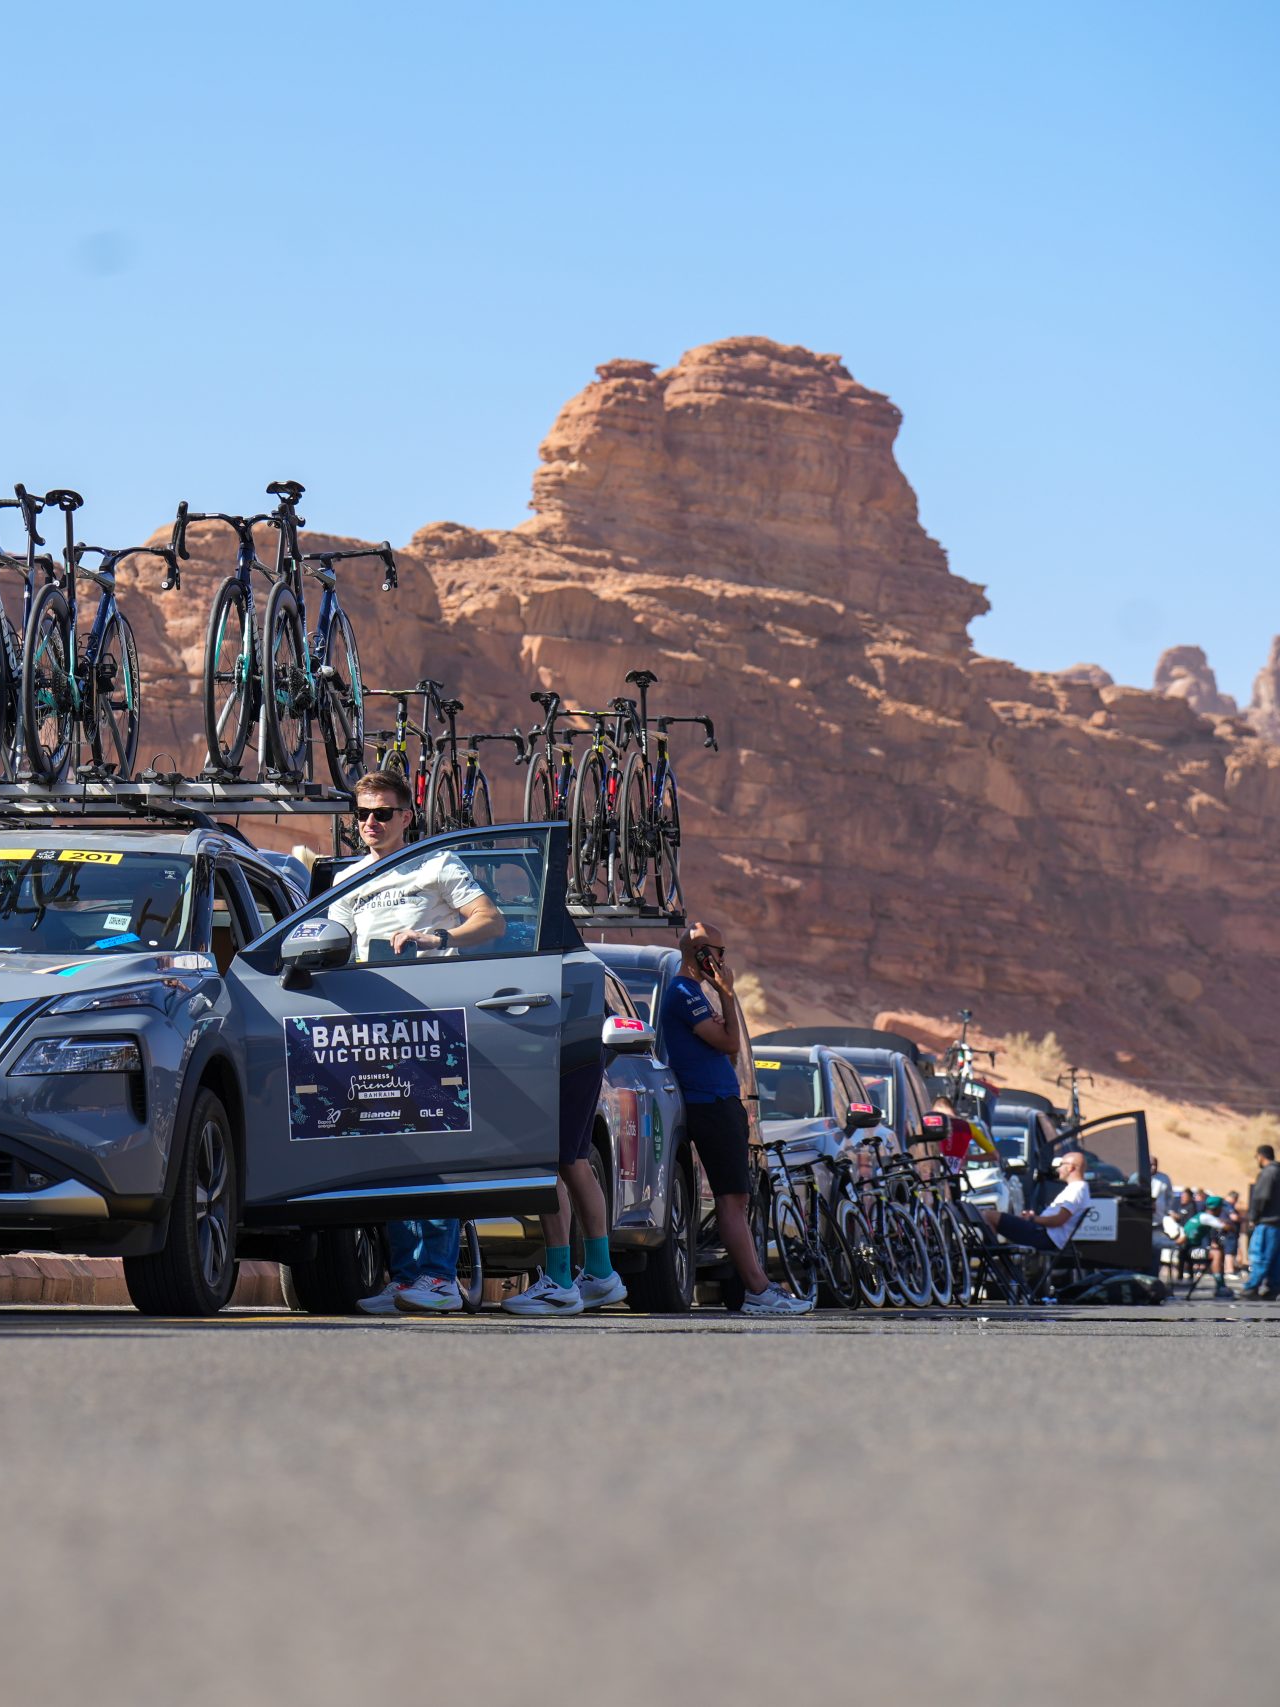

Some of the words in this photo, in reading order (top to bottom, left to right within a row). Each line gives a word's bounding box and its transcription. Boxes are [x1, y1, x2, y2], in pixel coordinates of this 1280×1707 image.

[70, 852, 112, 862] 201
[312, 1020, 440, 1048] BAHRAIN
[314, 1044, 441, 1064] VICTORIOUS
[348, 1075, 414, 1100] friendly
[359, 1110, 401, 1119] Bianchi
